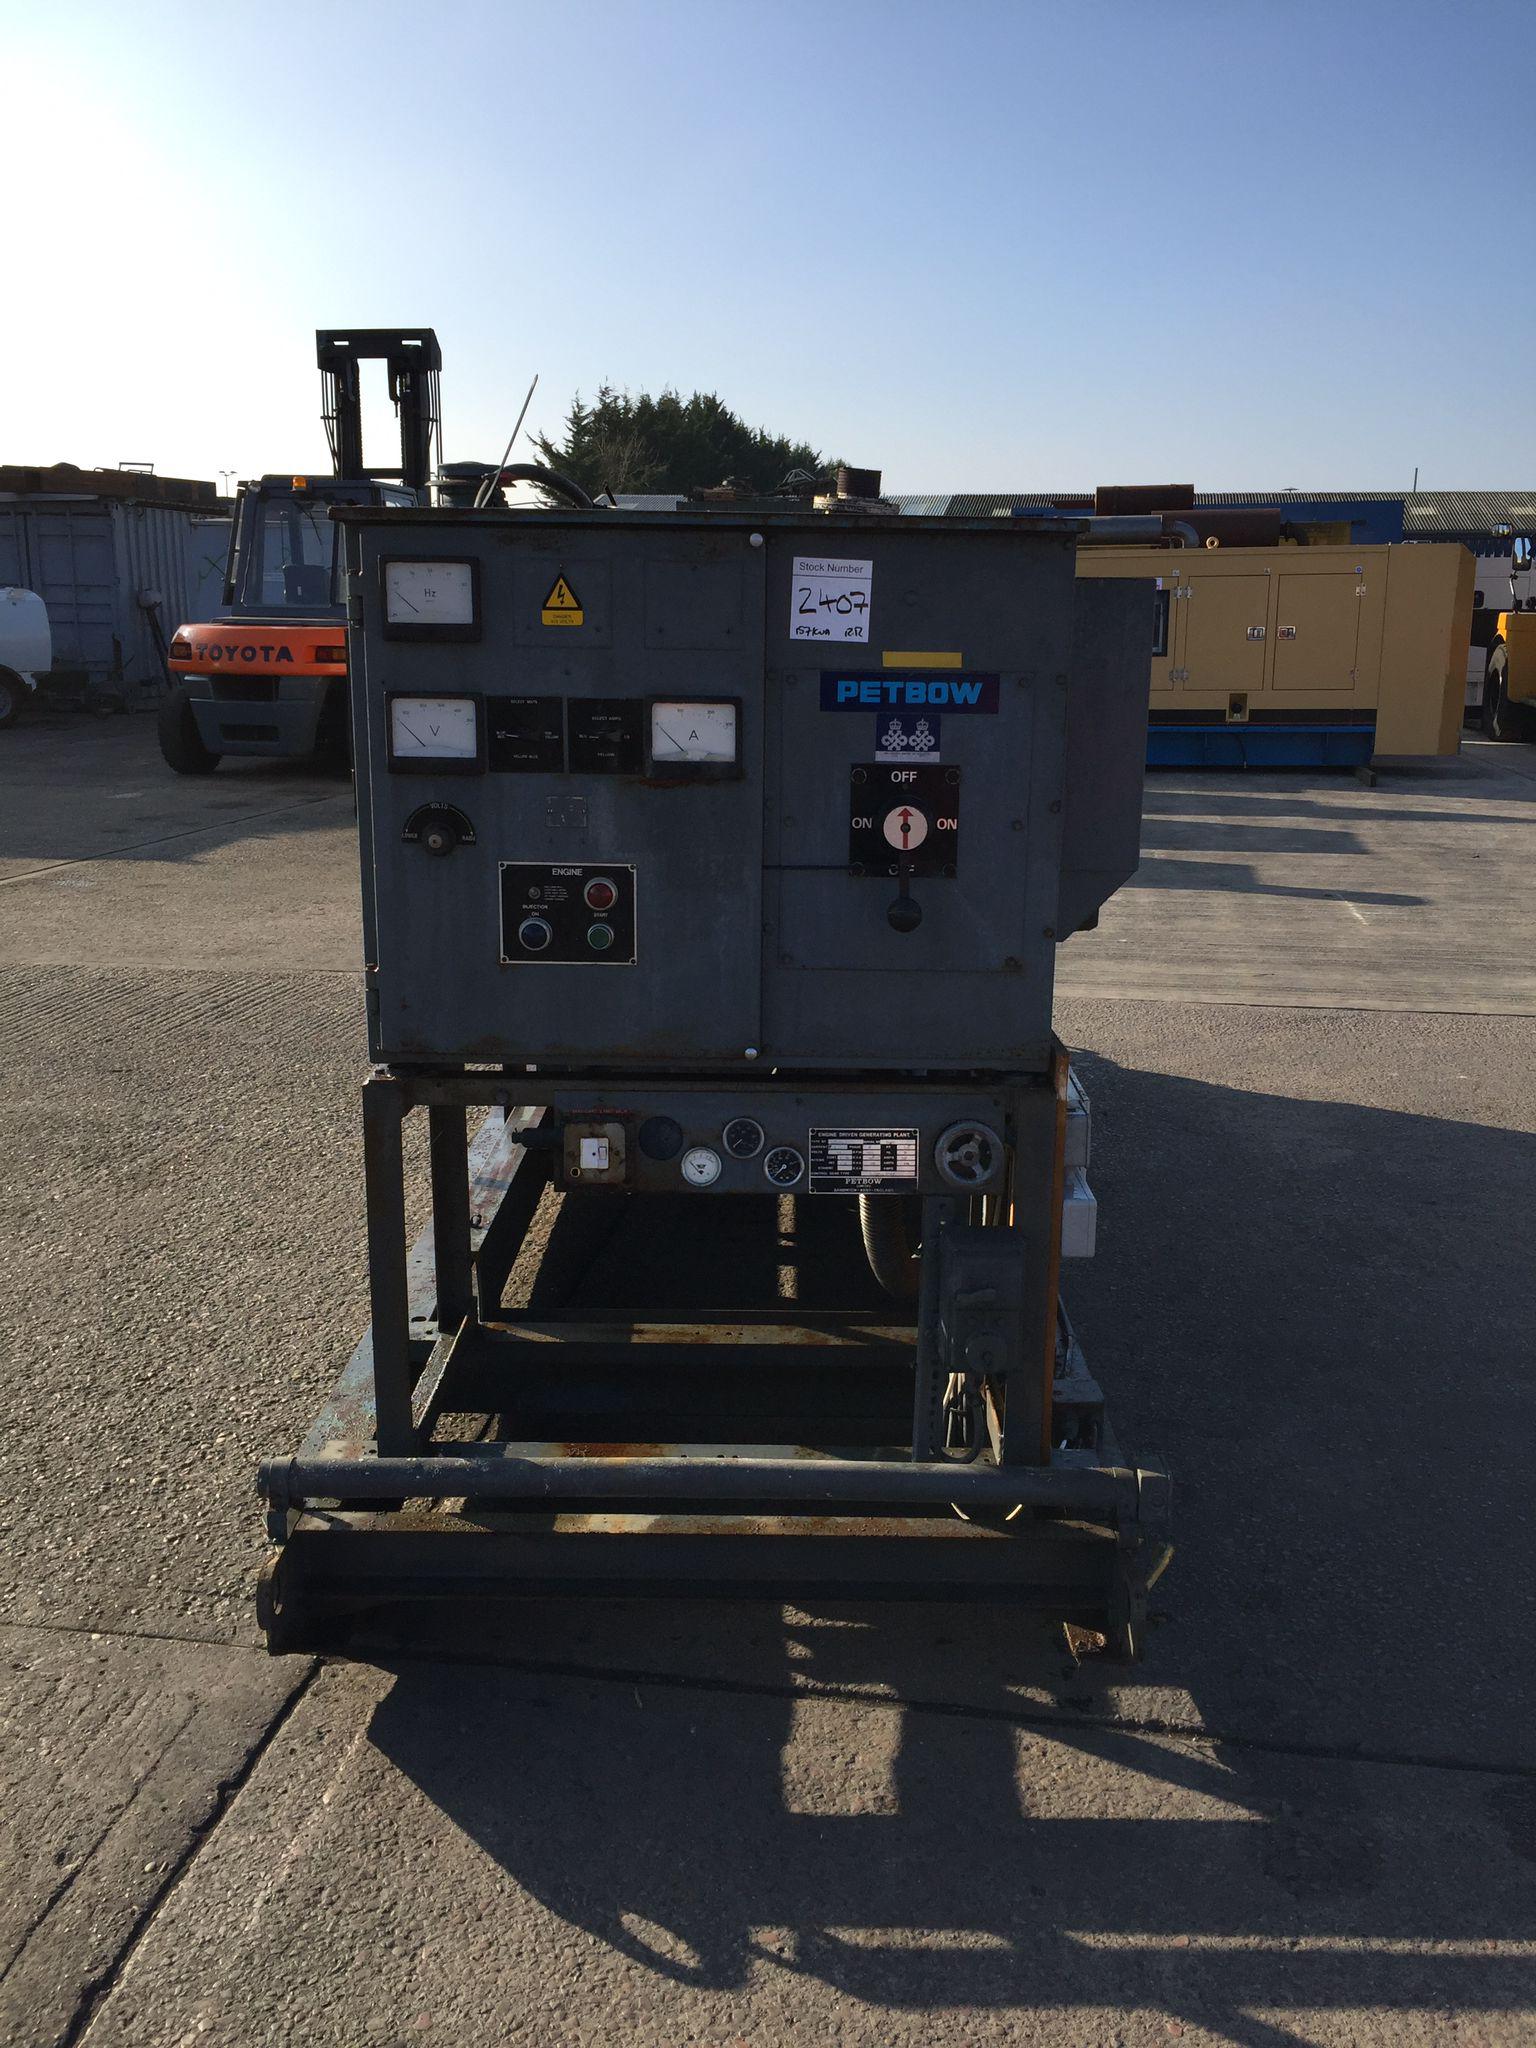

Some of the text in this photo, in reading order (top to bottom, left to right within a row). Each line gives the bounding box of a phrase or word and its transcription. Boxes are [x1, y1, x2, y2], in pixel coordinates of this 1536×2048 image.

[799, 562, 864, 574] Stock Number
[424, 588, 437, 598] Hz
[799, 587, 869, 615] 2407
[196, 643, 295, 663] TOYOTA
[837, 680, 984, 705] PETBOW
[430, 725, 440, 737] V
[688, 729, 700, 741] A
[890, 771, 918, 783] OFF
[852, 817, 873, 829] ON
[936, 818, 958, 830] ON
[552, 868, 583, 877] ENGINE
